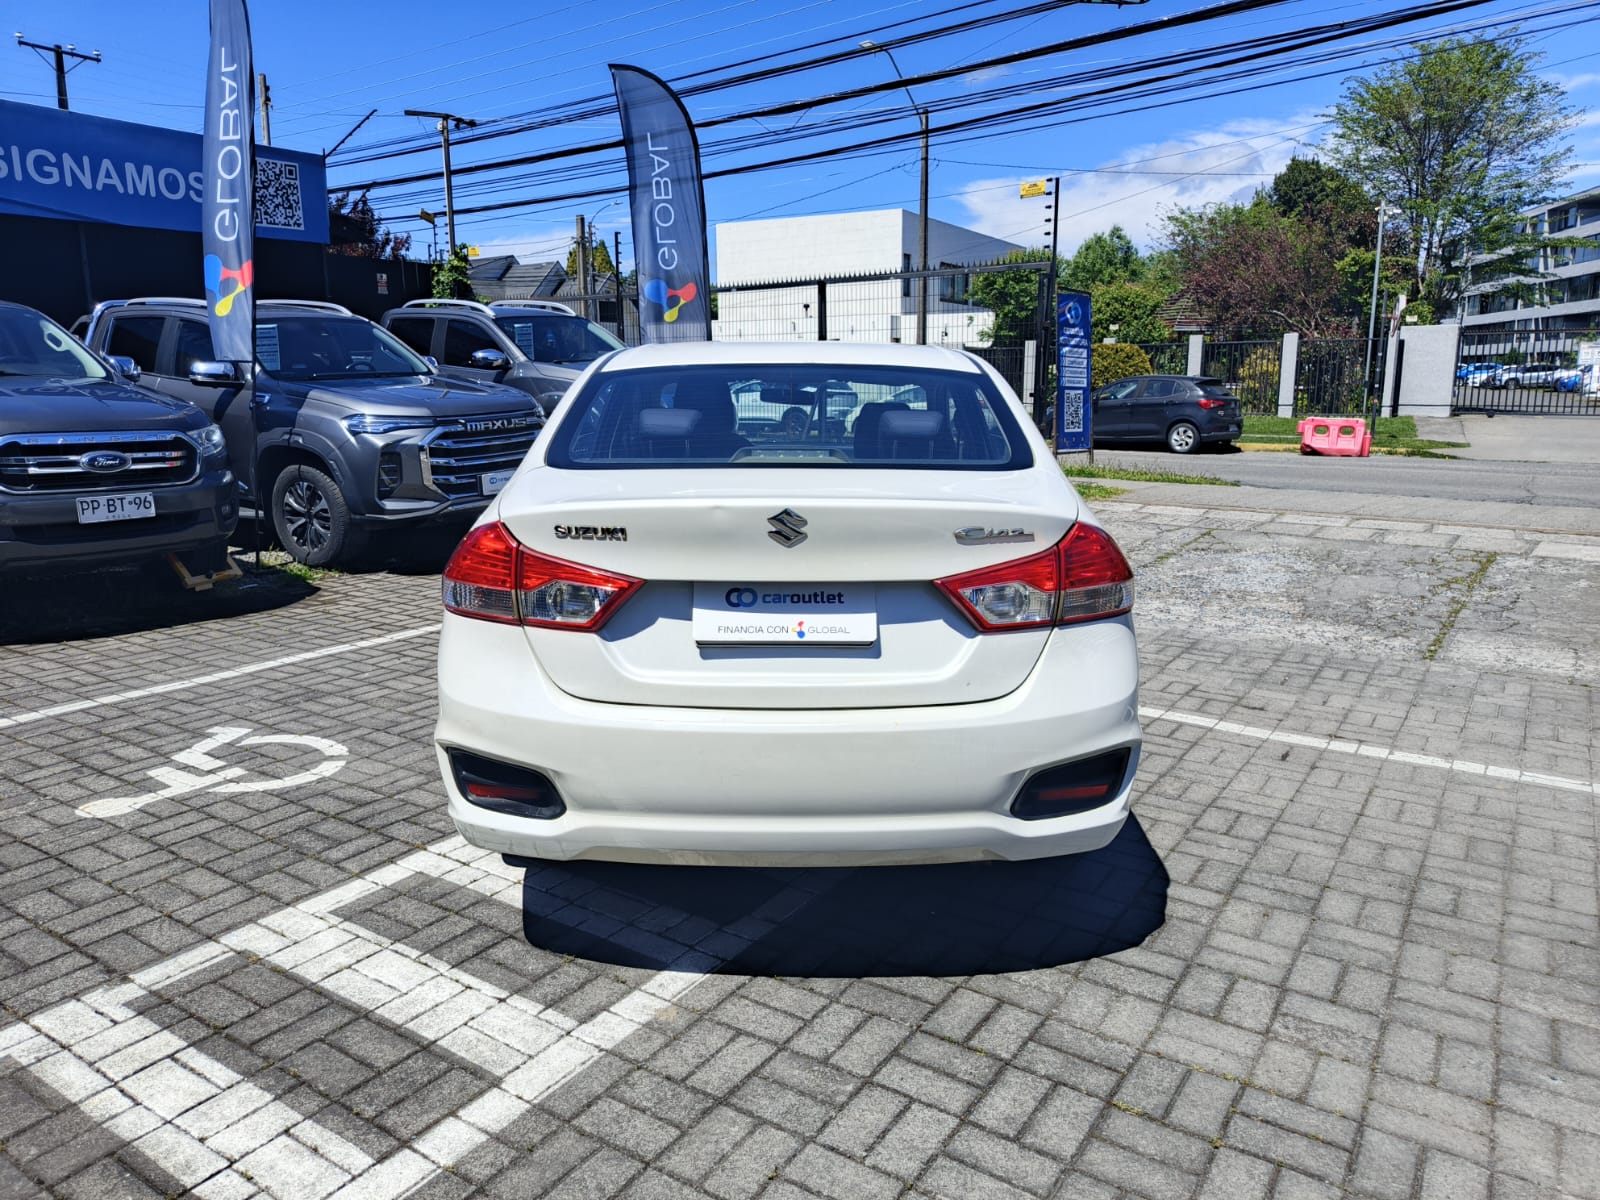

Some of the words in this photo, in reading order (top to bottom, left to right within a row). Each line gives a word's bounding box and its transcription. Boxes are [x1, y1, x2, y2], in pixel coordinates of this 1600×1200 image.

[214, 47, 242, 242] GLOBAL
[647, 132, 678, 270] GLOBAL
[466, 418, 527, 432] MAXUS
[554, 525, 627, 541] SUZUKI
[762, 591, 845, 605] caroutlet
[717, 626, 764, 635] FINANCIA
[766, 626, 789, 635] CON
[807, 626, 850, 635] GLOBAL
